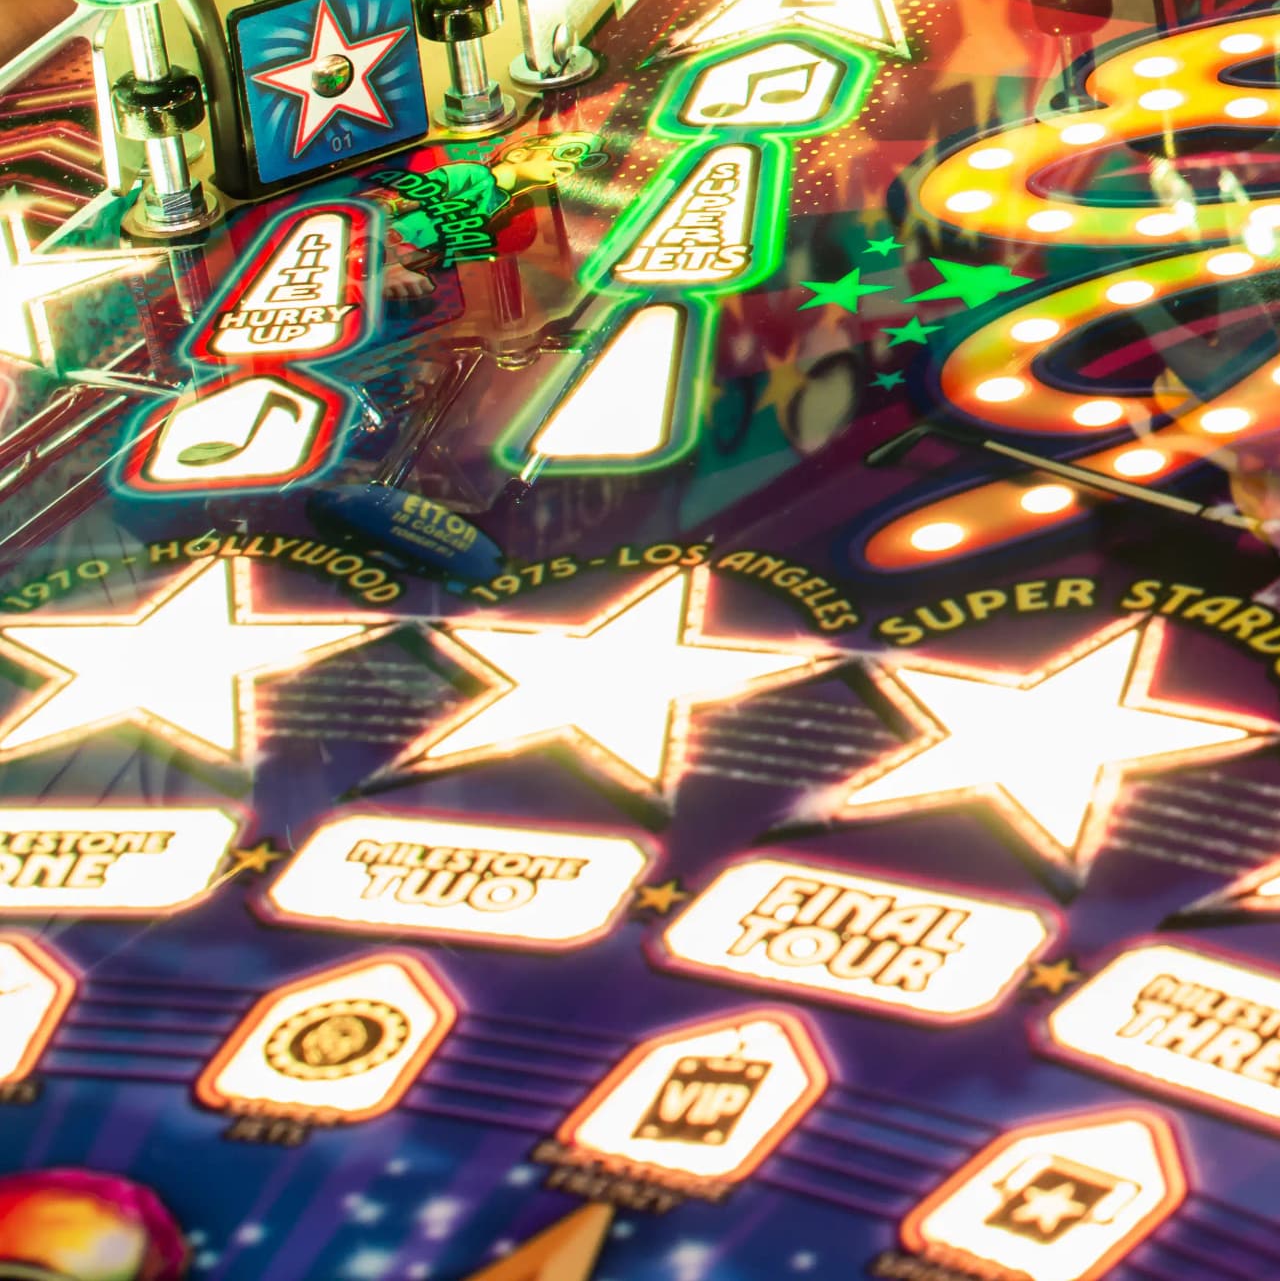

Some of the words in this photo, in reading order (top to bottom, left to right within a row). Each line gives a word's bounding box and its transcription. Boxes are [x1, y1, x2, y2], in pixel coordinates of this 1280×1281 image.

[330, 134, 353, 154] 01
[370, 168, 498, 269] ADD-A-BALL
[655, 161, 742, 247] SUPER
[264, 233, 332, 303] LITE
[612, 245, 754, 273] JETS
[217, 304, 357, 330] HURRY
[248, 323, 309, 344] UP
[4, 557, 112, 611] 1970
[148, 534, 403, 604] HOLLYWOOD
[471, 556, 578, 602] 1975
[618, 544, 709, 567] LOS
[716, 550, 859, 632] ANGELES
[878, 578, 1097, 646] SUPER
[345, 838, 591, 881] MILESTONE
[359, 864, 538, 913] TWO
[752, 875, 973, 954] FINAL
[726, 912, 949, 994] TOUR
[657, 1079, 752, 1126] VIP
